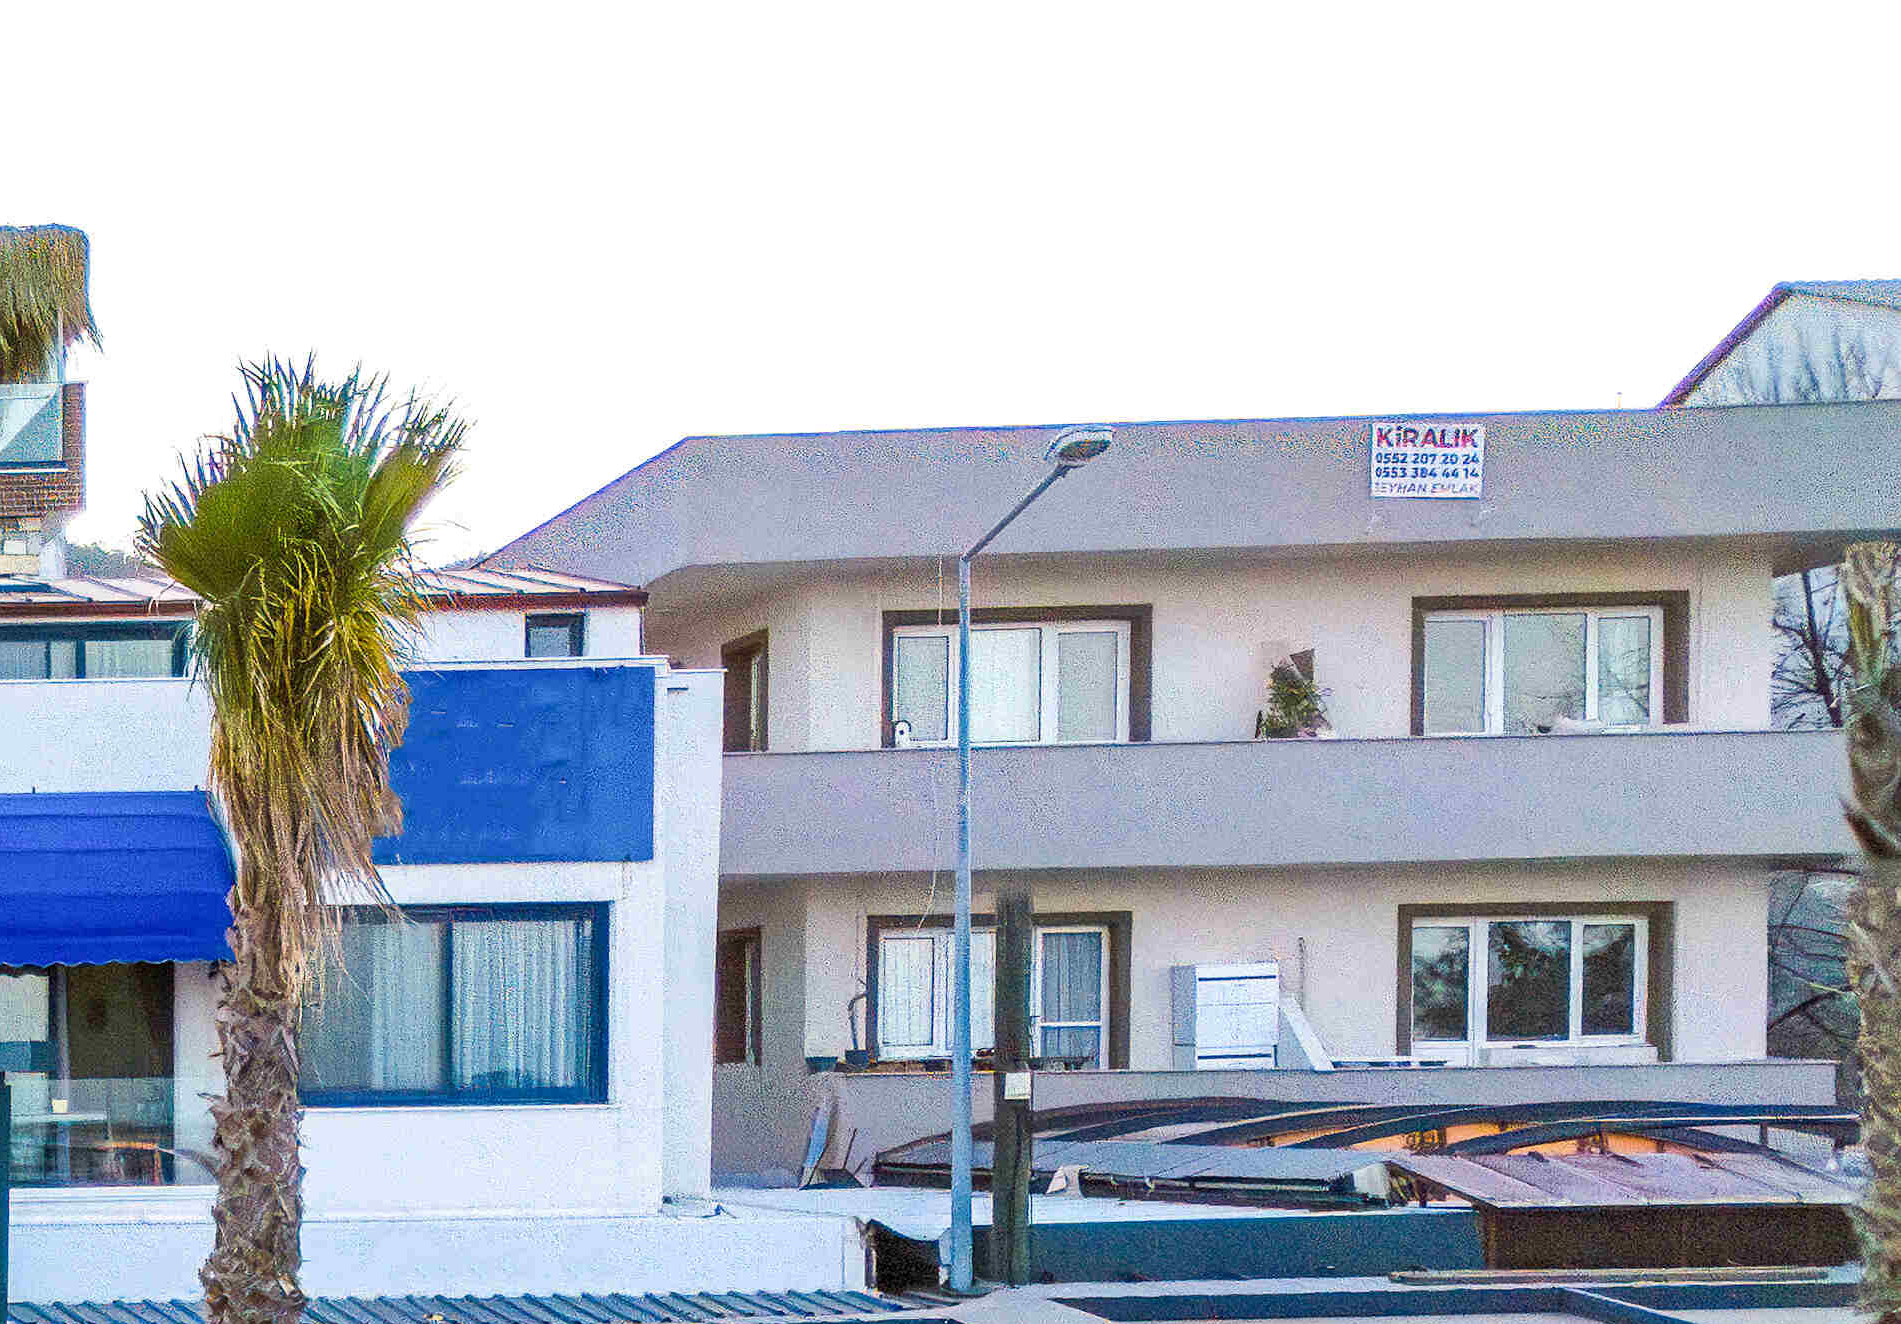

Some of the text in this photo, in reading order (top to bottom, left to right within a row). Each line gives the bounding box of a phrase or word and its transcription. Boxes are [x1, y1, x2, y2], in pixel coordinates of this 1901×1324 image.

[1375, 452, 1480, 464] 0552 207 20 24
[1375, 467, 1407, 479] 0553
[1411, 467, 1437, 478] 384
[1462, 467, 1480, 478] 14
